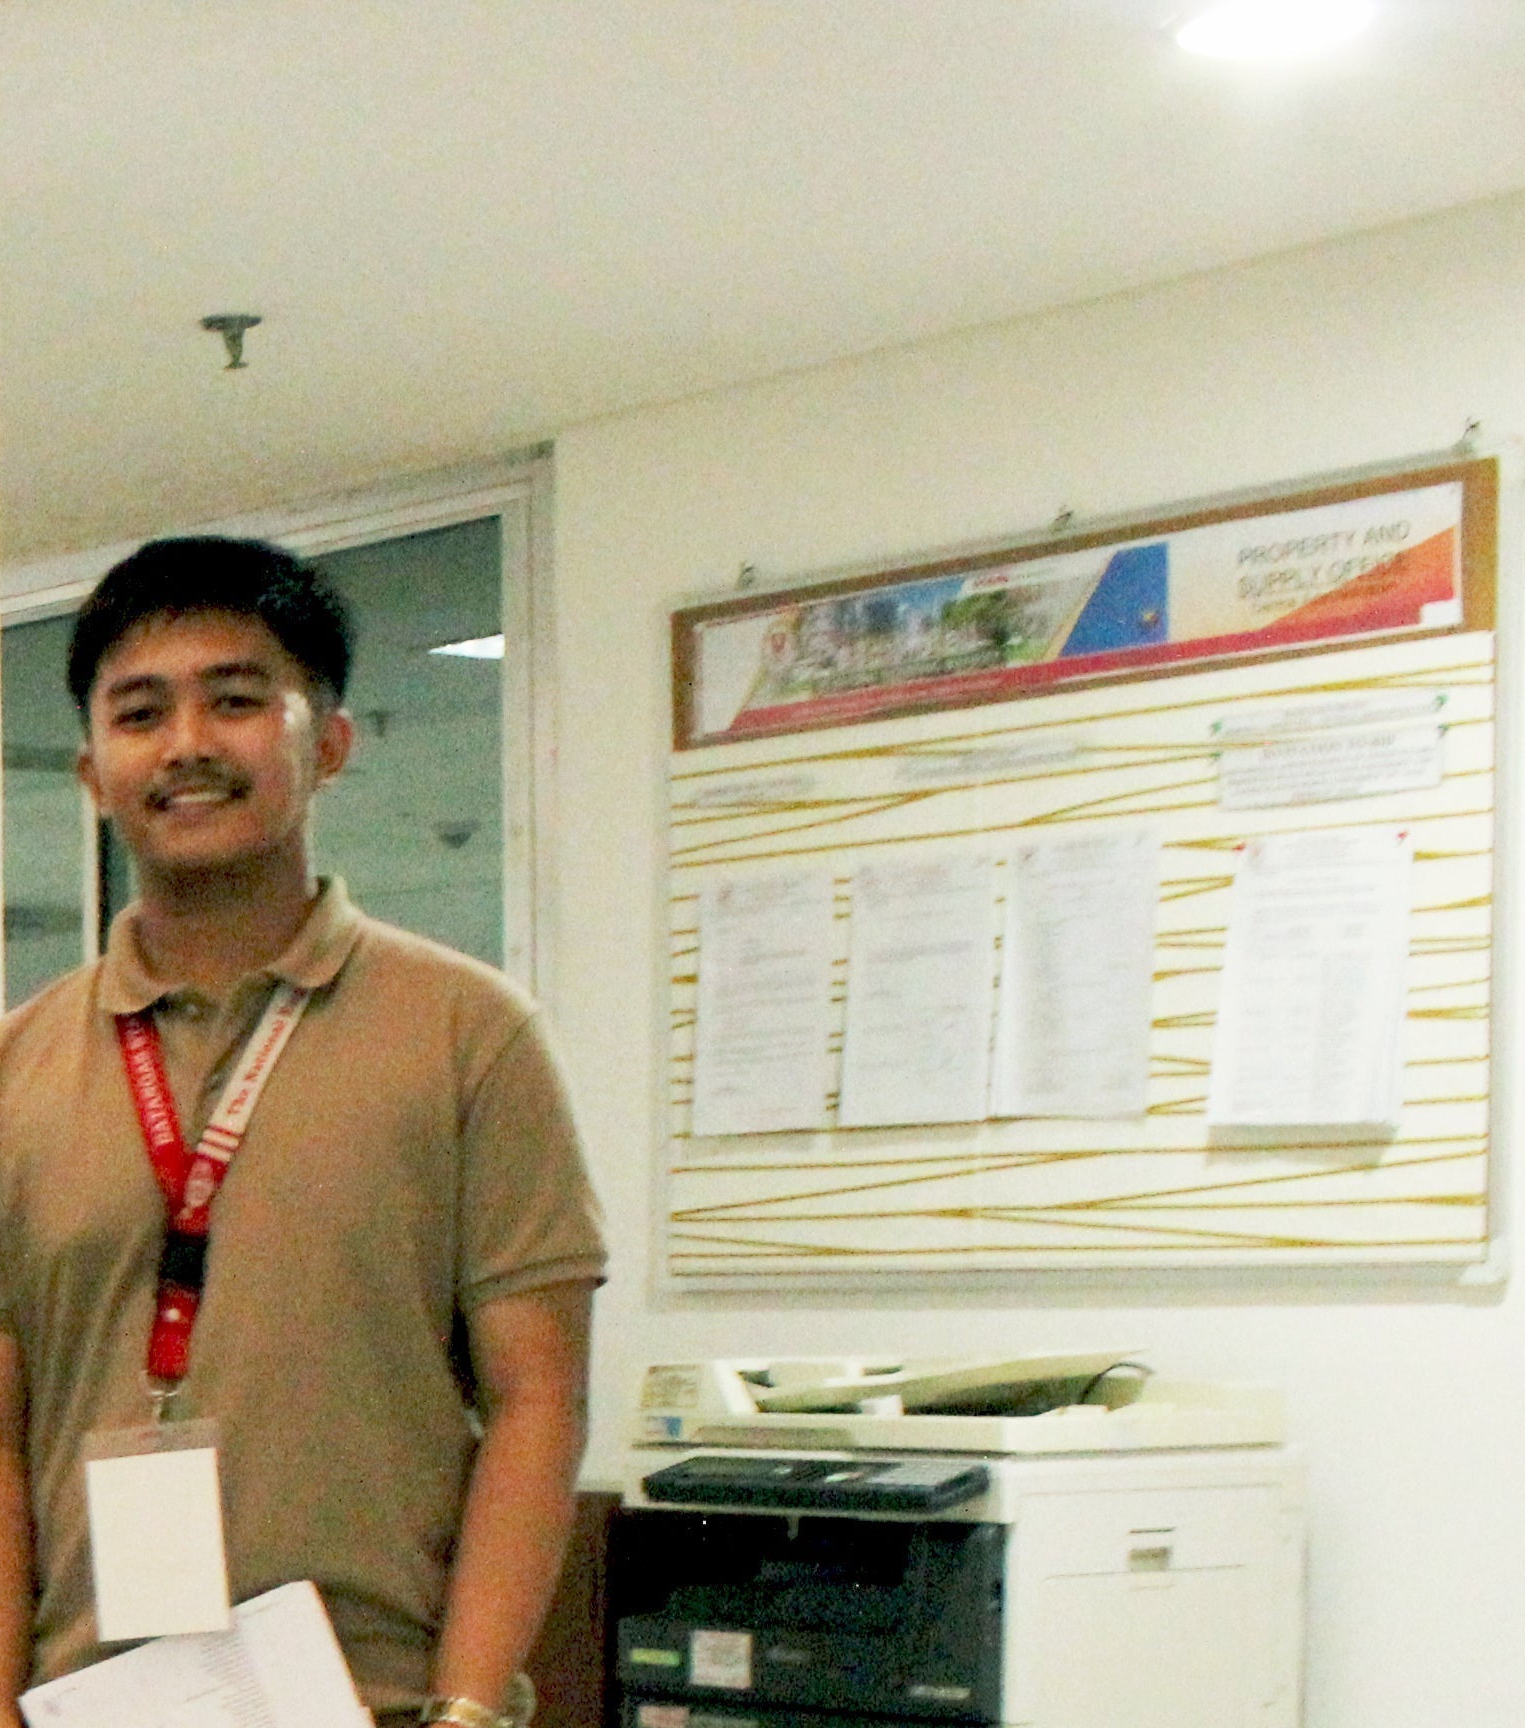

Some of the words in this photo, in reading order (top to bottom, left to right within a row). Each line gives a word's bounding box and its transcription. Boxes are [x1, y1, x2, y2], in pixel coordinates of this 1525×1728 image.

[1237, 529, 1357, 567] PROPERTY
[1362, 519, 1411, 545] AND
[1237, 567, 1324, 599] SUPPLY
